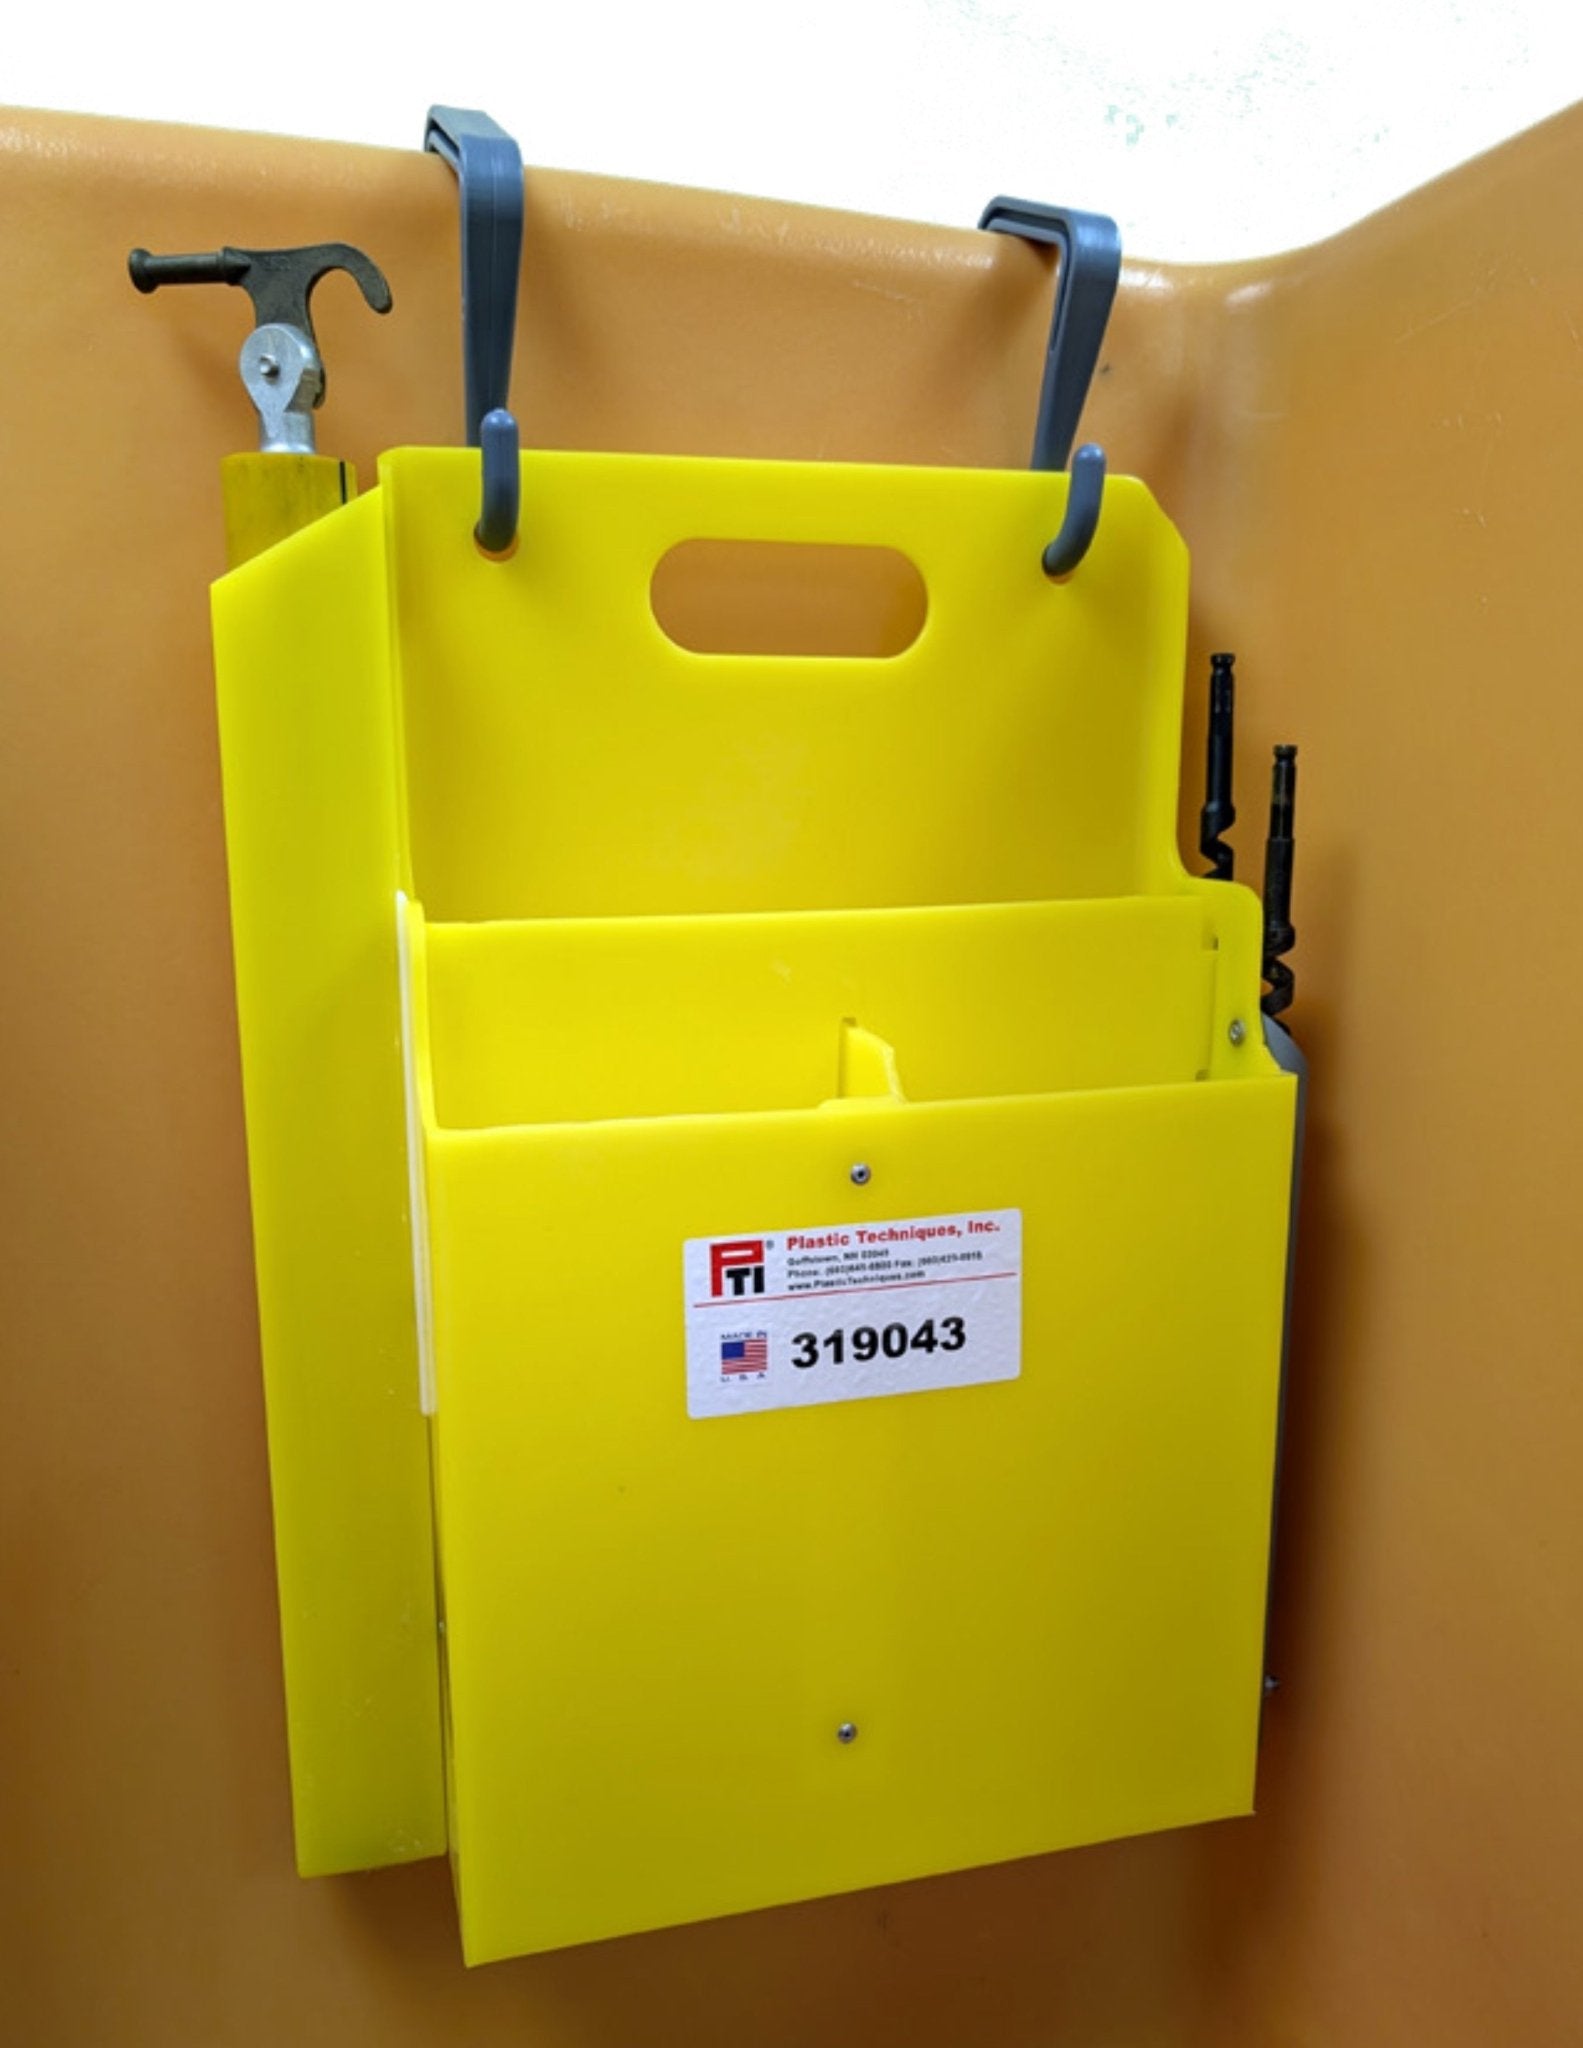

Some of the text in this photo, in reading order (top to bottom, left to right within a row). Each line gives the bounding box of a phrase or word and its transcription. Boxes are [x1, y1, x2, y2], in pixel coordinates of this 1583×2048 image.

[787, 1220, 1001, 1250] Plastic Techniques, Inc.
[710, 1240, 765, 1298] PTI
[791, 1316, 967, 1369] 319043
